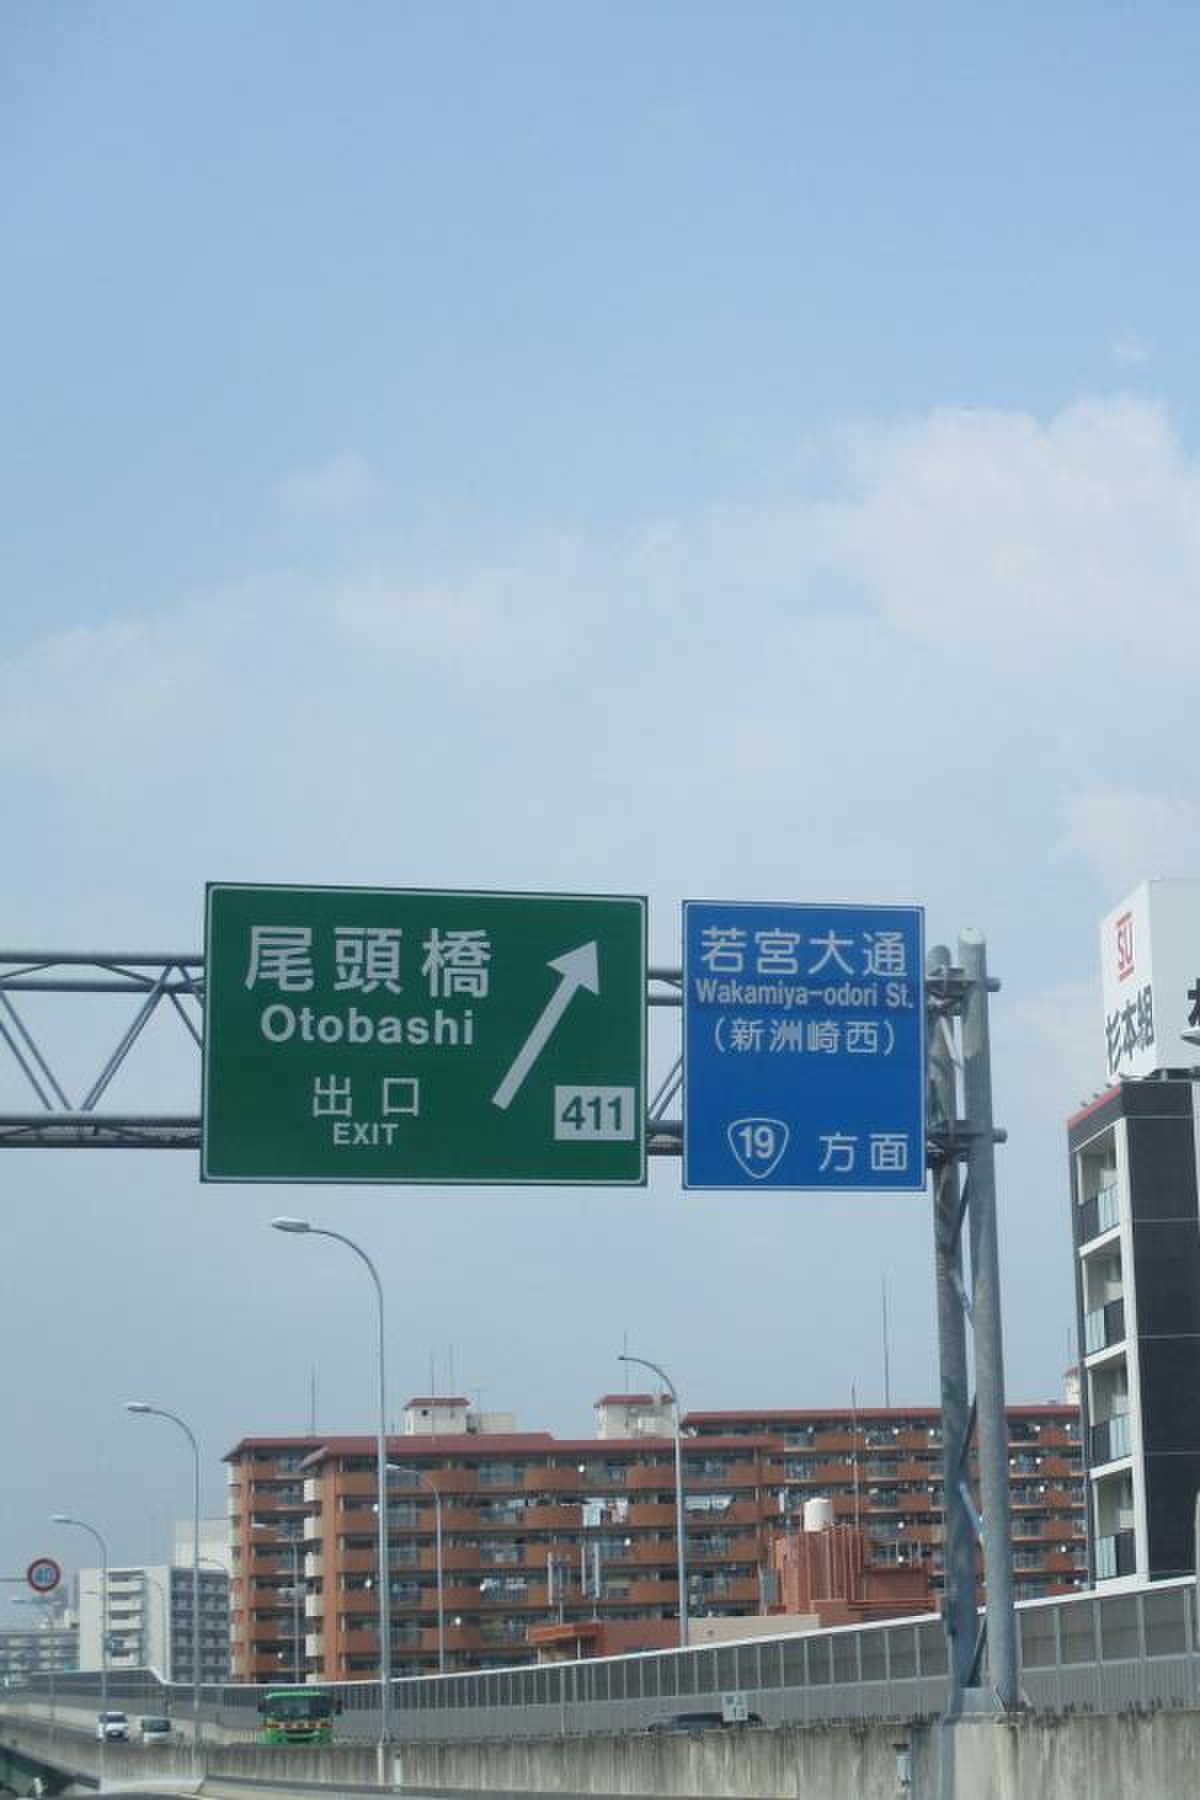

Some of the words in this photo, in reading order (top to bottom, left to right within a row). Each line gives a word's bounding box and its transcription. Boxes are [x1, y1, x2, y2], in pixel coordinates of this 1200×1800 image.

[244, 925, 492, 998] 尾頭橋
[701, 926, 908, 977] 若宮大通
[1117, 920, 1134, 972] SU
[695, 978, 878, 1009] Wakamiya-odori
[886, 981, 914, 1009] St.
[260, 1003, 474, 1045] Otobashi
[714, 1016, 896, 1056] (新洲崎西)
[312, 1074, 420, 1117] 出口
[560, 1095, 622, 1131] 411
[332, 1122, 399, 1145] EXIT
[737, 1124, 775, 1160] 19
[818, 1131, 909, 1172] 方面
